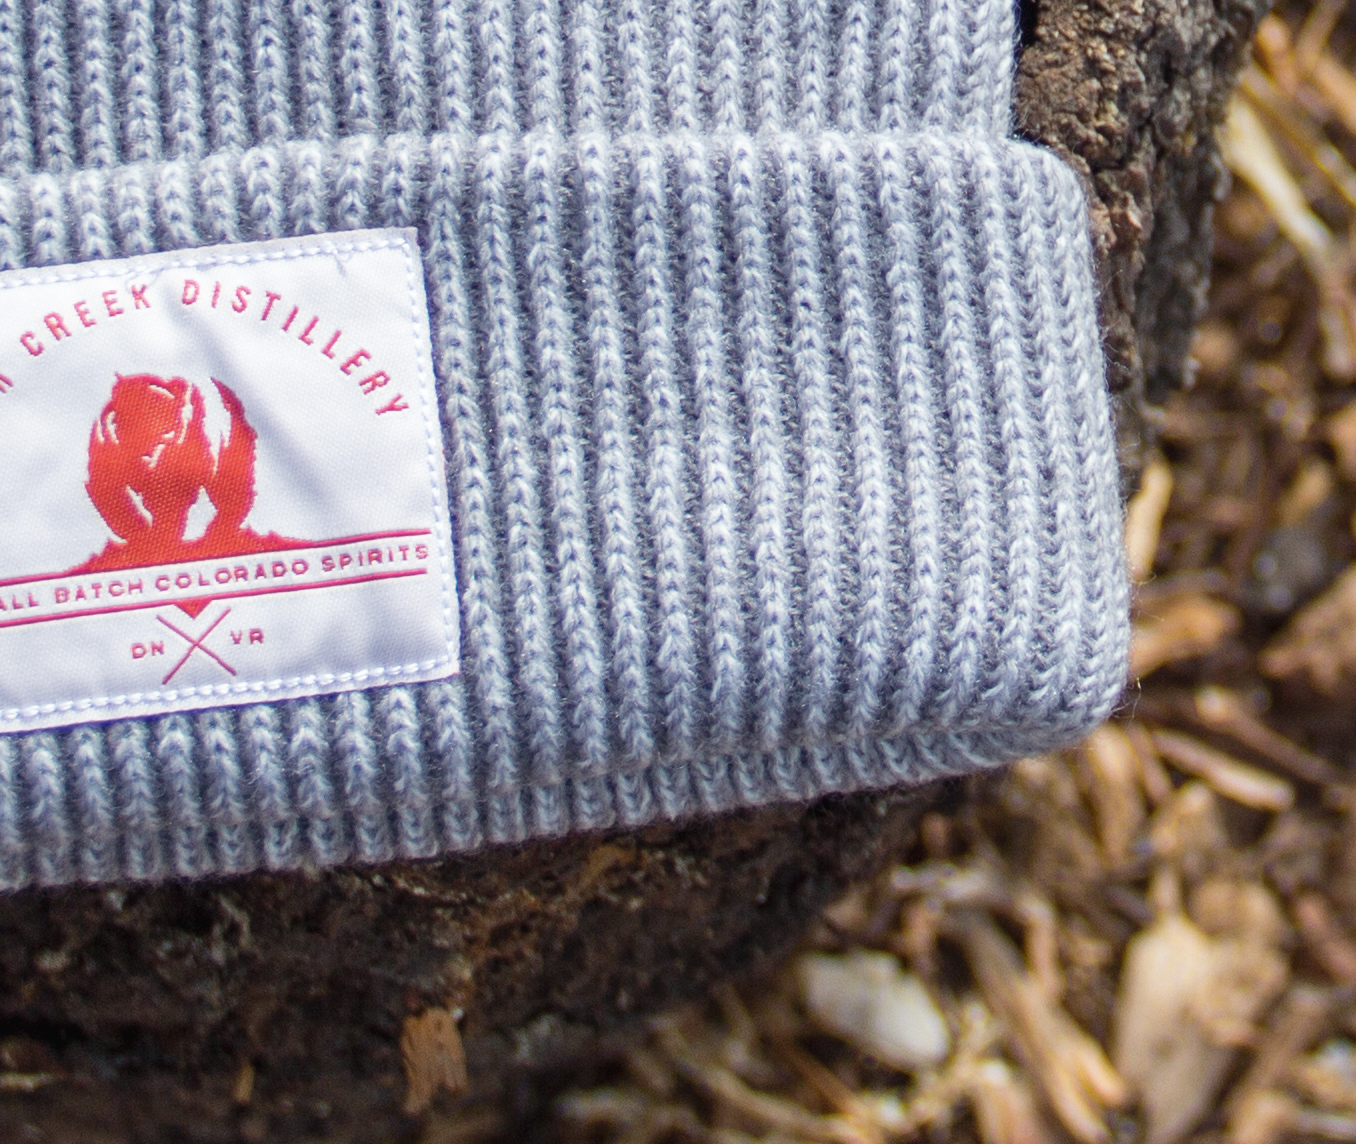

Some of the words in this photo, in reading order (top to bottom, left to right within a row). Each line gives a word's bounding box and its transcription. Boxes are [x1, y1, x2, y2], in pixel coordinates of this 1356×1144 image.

[20, 285, 150, 358] CREEK
[182, 279, 409, 416] DISTILLERY
[55, 579, 144, 604] BATCH
[155, 560, 310, 592] COLORADO
[321, 544, 429, 571] SPIRITS
[131, 641, 165, 659] DN
[230, 629, 264, 645] VR
